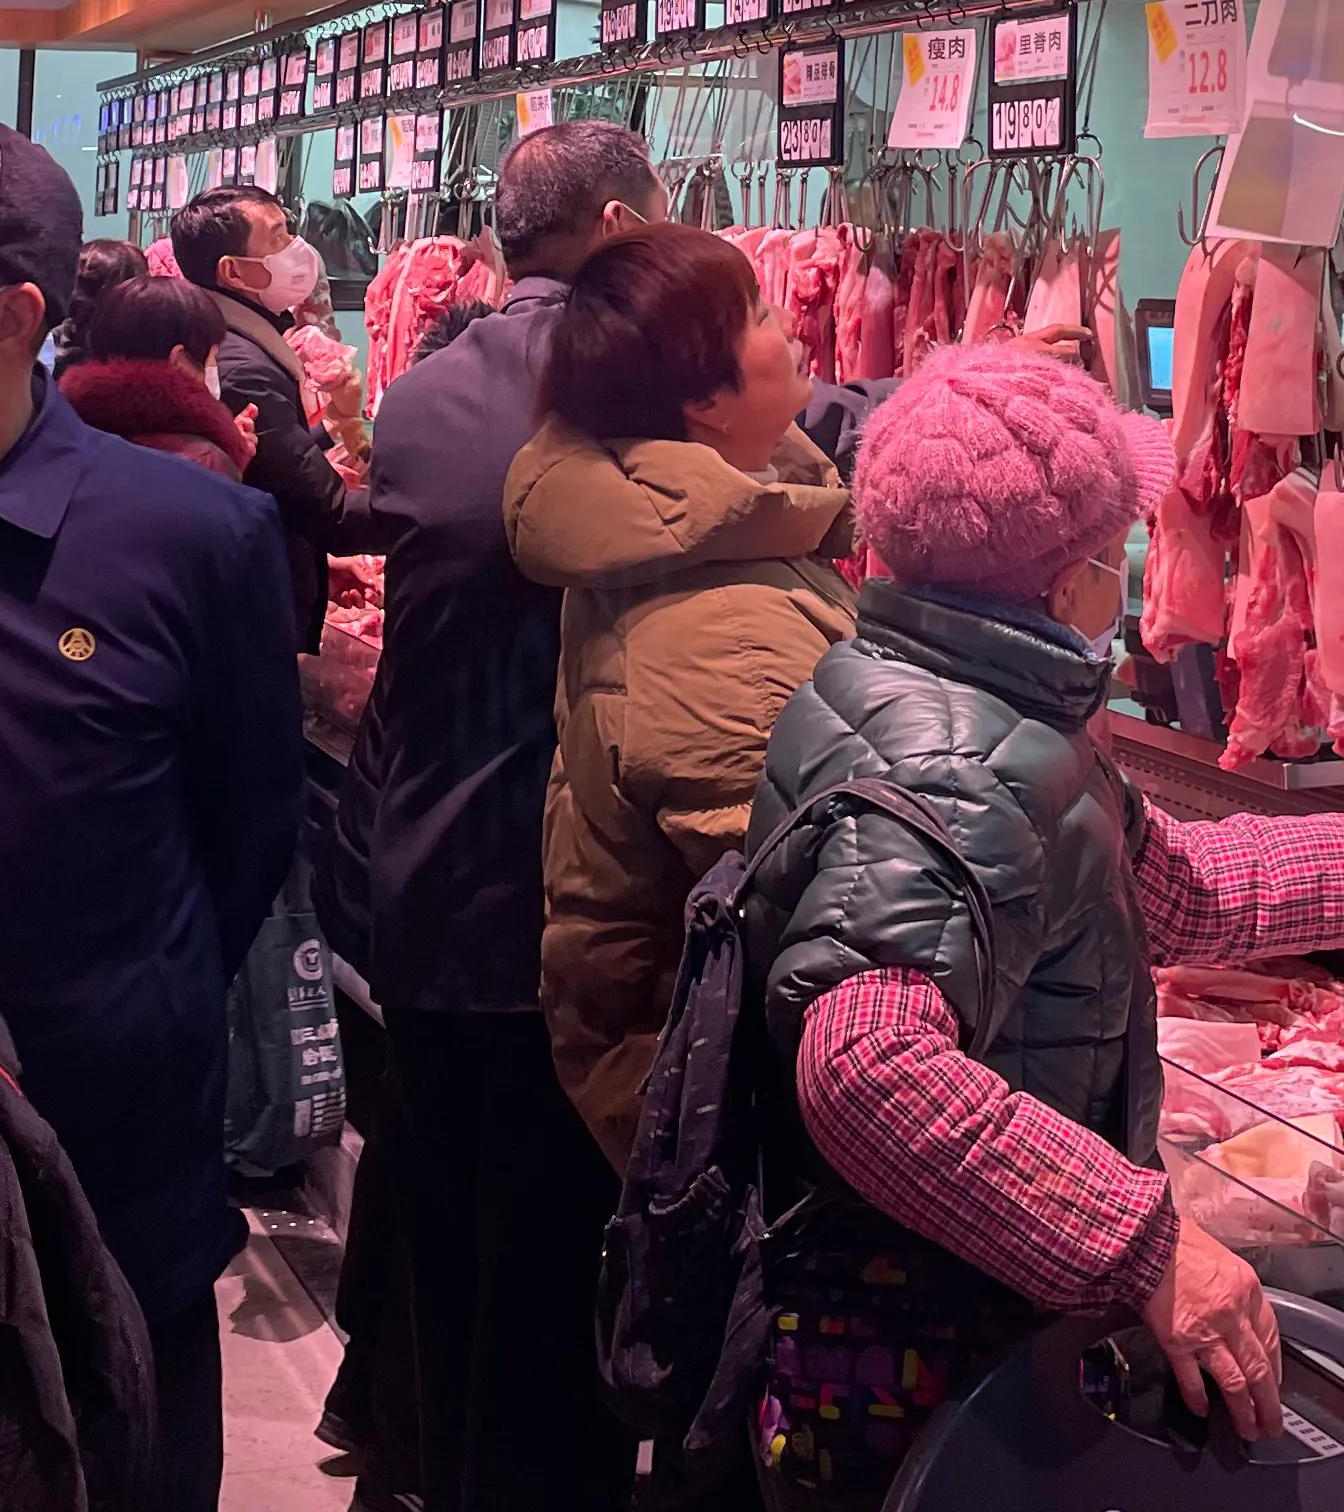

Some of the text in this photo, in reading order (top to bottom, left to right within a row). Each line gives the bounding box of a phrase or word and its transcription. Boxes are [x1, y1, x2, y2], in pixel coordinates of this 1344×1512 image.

[927, 35, 966, 60] 瘦肉
[1018, 29, 1063, 56] 里脊肉
[1188, 48, 1228, 94] 12.8
[929, 73, 961, 112] 14.8
[995, 102, 1044, 141] 19.80
